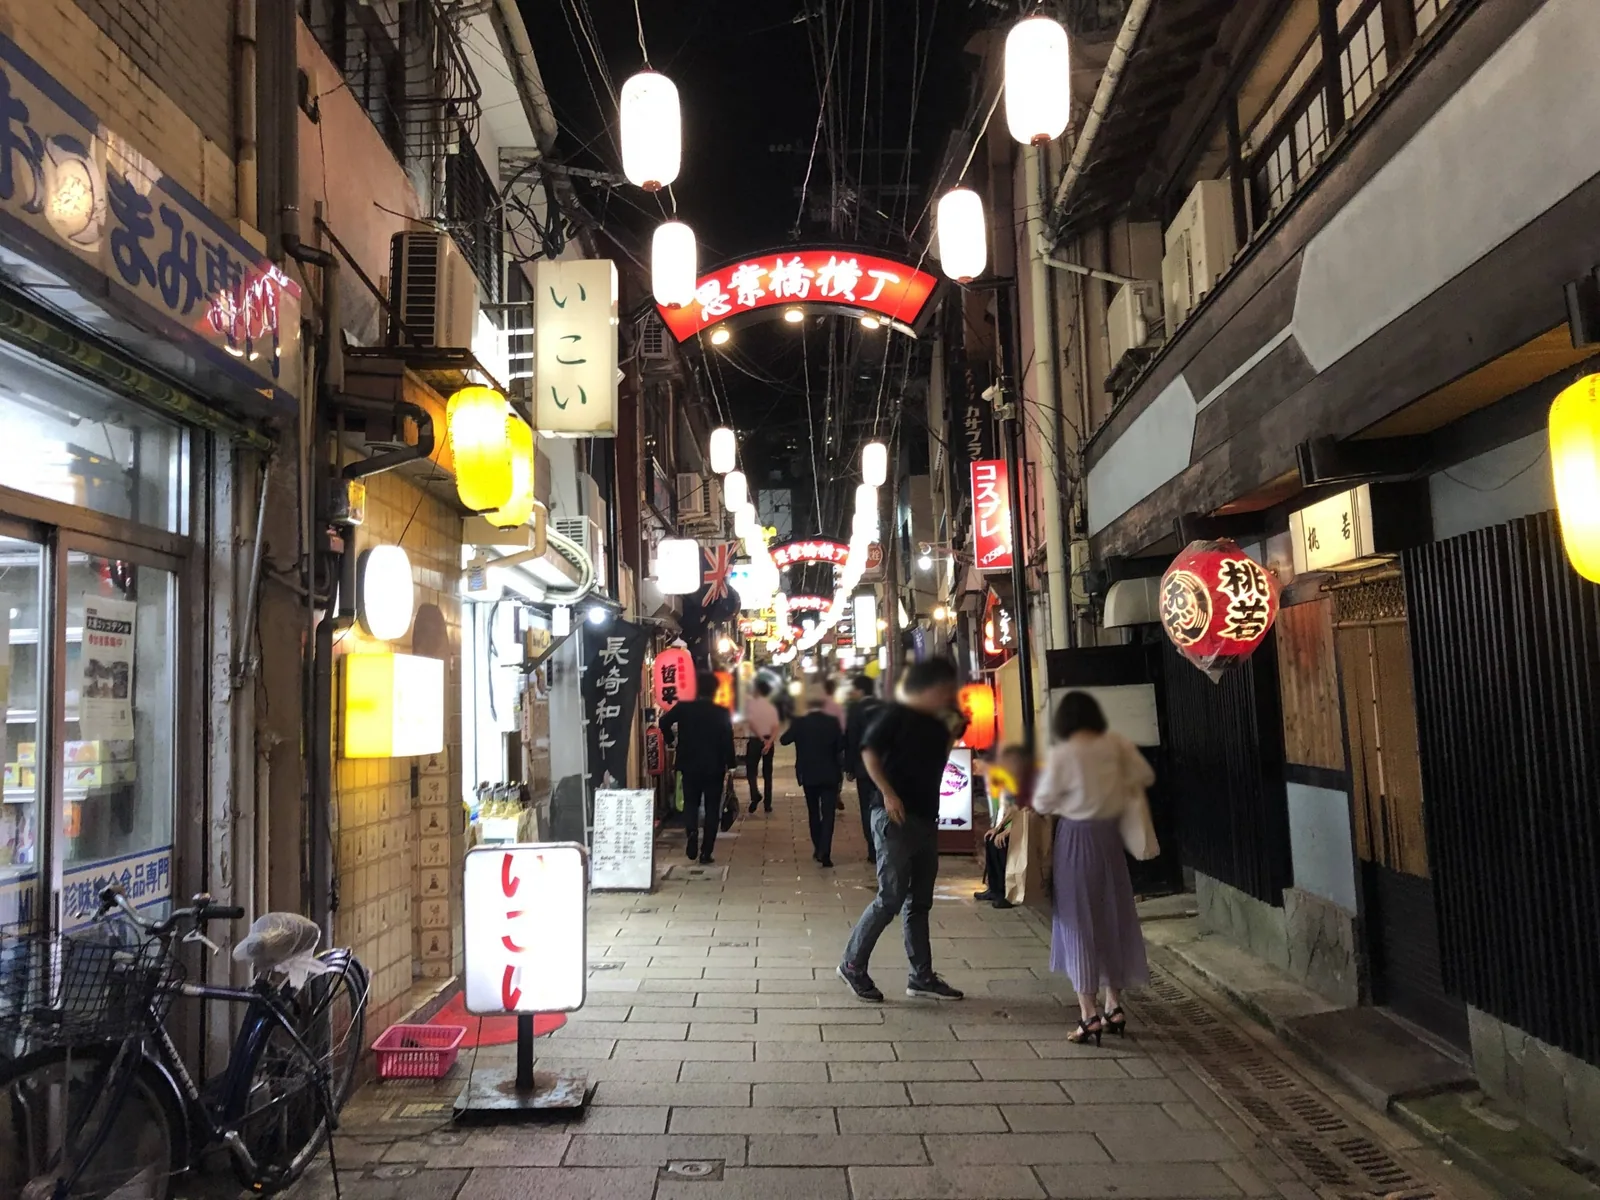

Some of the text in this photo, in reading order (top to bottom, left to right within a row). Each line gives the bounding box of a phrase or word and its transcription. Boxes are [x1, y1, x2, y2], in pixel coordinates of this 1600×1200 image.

[696, 255, 900, 322] 思案橋横丁
[549, 282, 587, 411] いこい
[1220, 559, 1270, 641] 桃若
[595, 636, 629, 760] 長崎和牛
